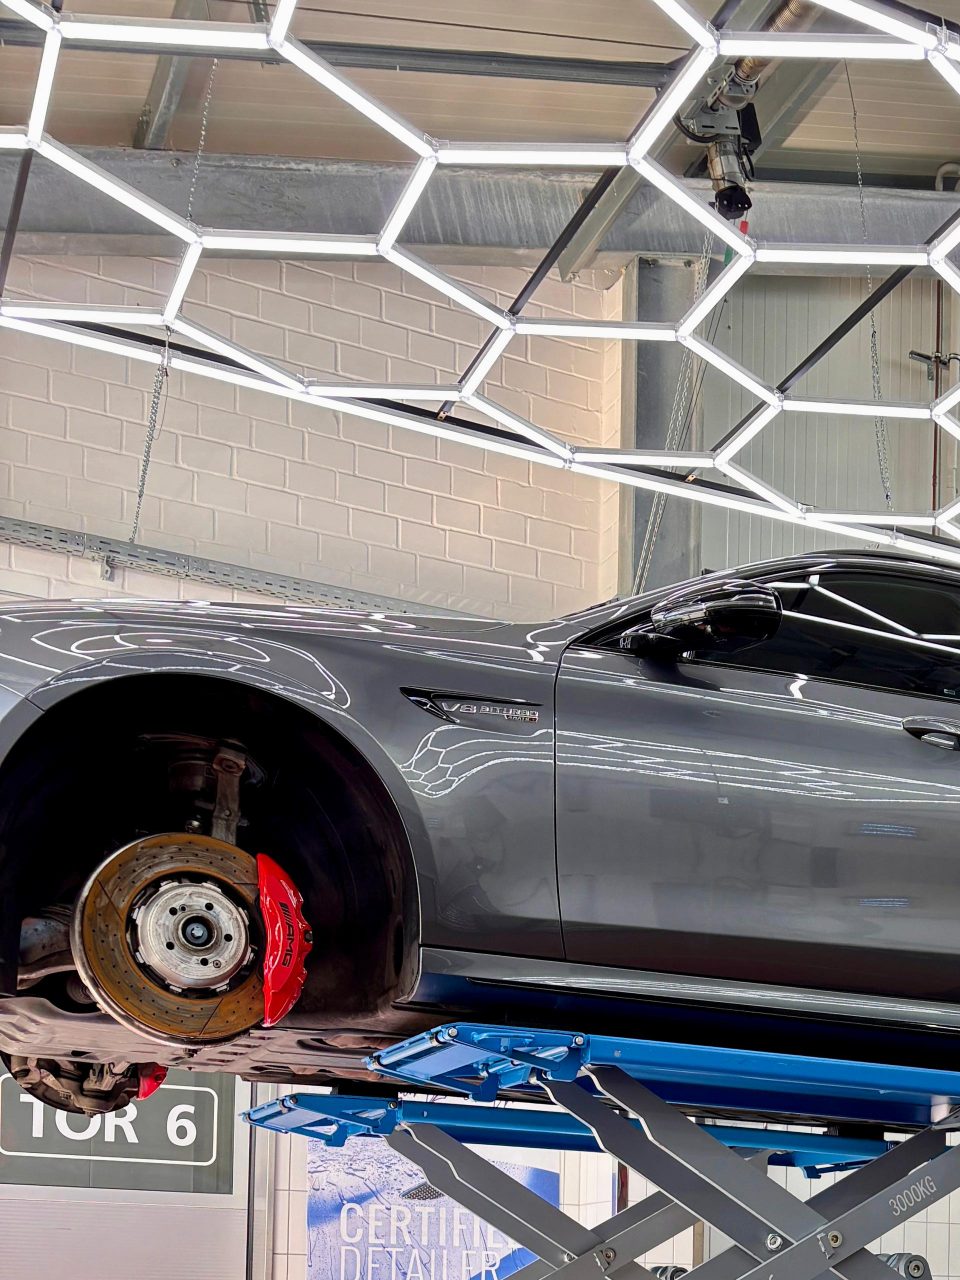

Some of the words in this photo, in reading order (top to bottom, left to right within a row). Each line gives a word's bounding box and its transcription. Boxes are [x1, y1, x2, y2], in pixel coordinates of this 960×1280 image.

[441, 702, 477, 713] V8
[281, 923, 295, 968] AMG
[19, 1093, 139, 1143] TOR
[166, 1104, 197, 1146] 6
[888, 1175, 937, 1216] 3000KG
[340, 1202, 521, 1248] CERTIFI
